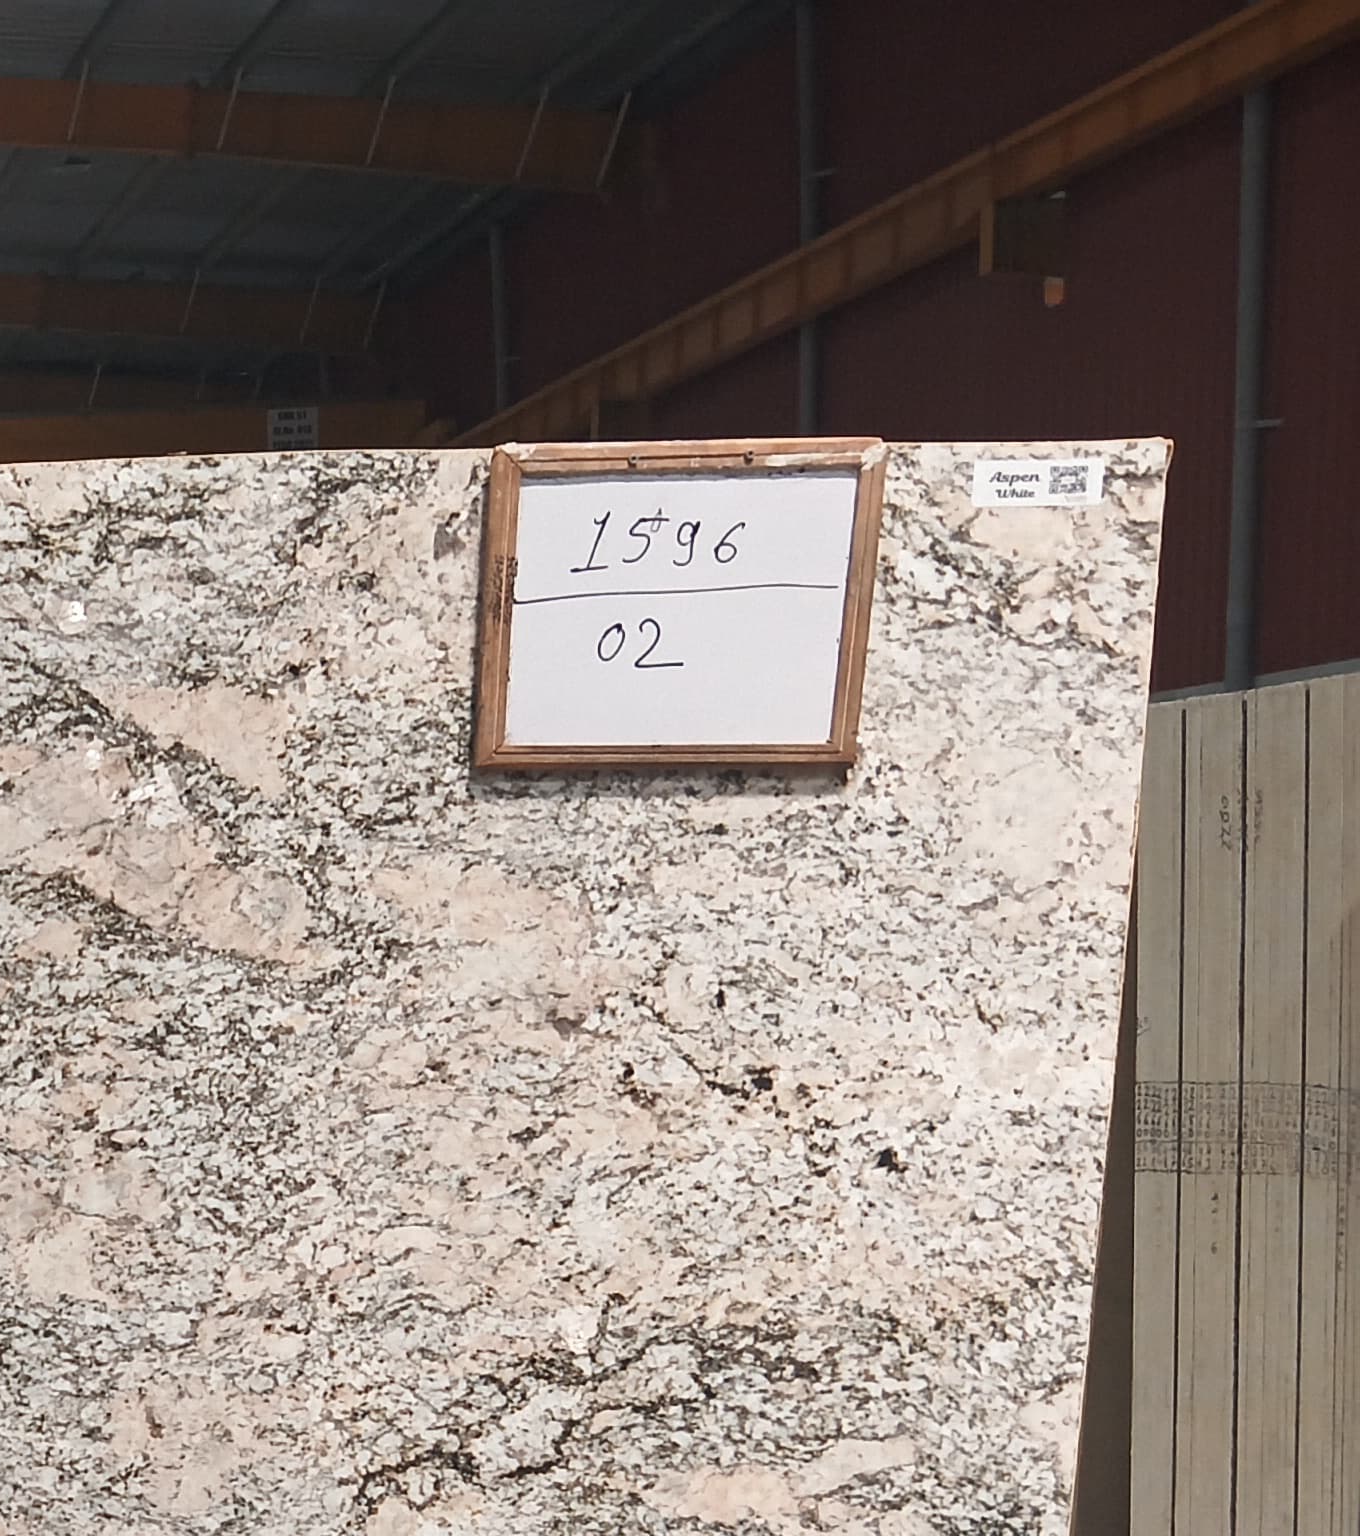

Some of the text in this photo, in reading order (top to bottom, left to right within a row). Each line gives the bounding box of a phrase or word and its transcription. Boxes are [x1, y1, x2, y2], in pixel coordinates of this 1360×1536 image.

[989, 472, 1040, 487] Aspen
[995, 488, 1035, 499] White
[570, 510, 746, 573] 1596
[597, 618, 684, 668] 02
